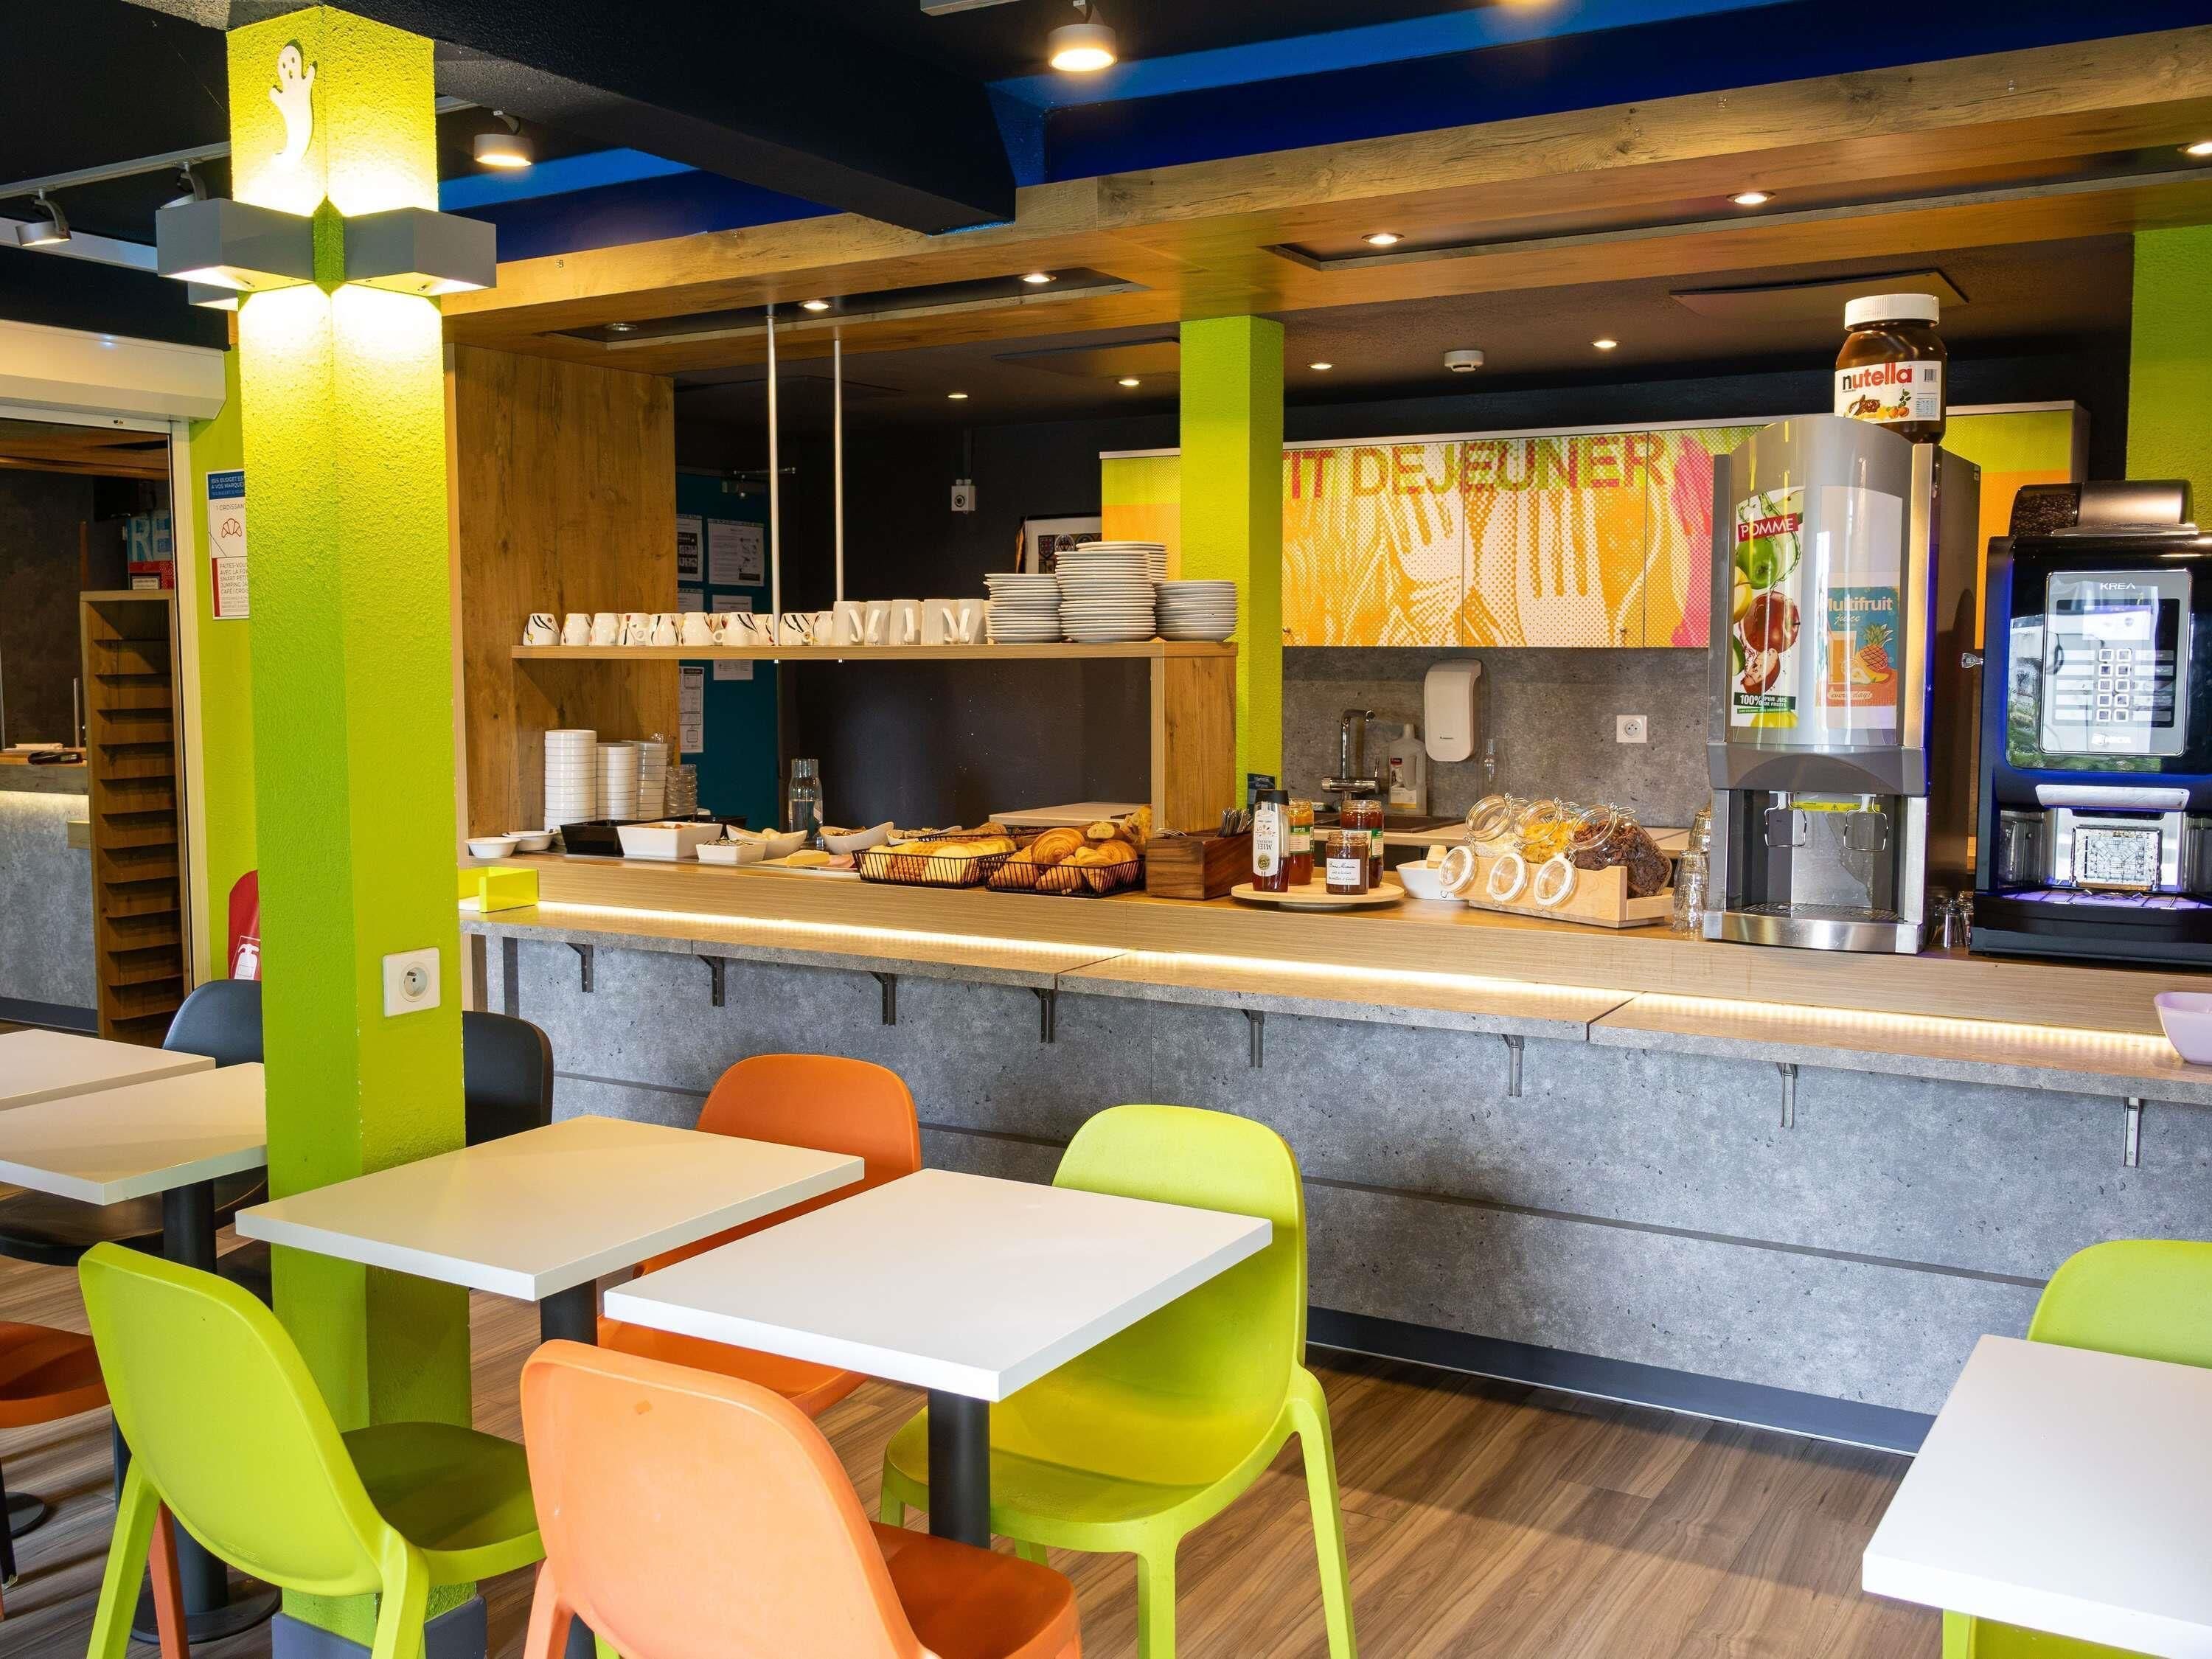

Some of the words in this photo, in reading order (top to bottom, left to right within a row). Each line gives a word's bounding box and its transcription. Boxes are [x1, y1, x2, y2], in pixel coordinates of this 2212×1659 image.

[1843, 362, 1913, 390] nutella
[1283, 450, 1334, 499] IT
[1352, 434, 1665, 497] DEJEUNER
[219, 503, 244, 511] CROISSAN
[1740, 518, 1794, 538] POMME
[2100, 582, 2136, 591] KREA
[1827, 596, 1893, 612] ultifruit
[1740, 695, 1763, 706] 100%
